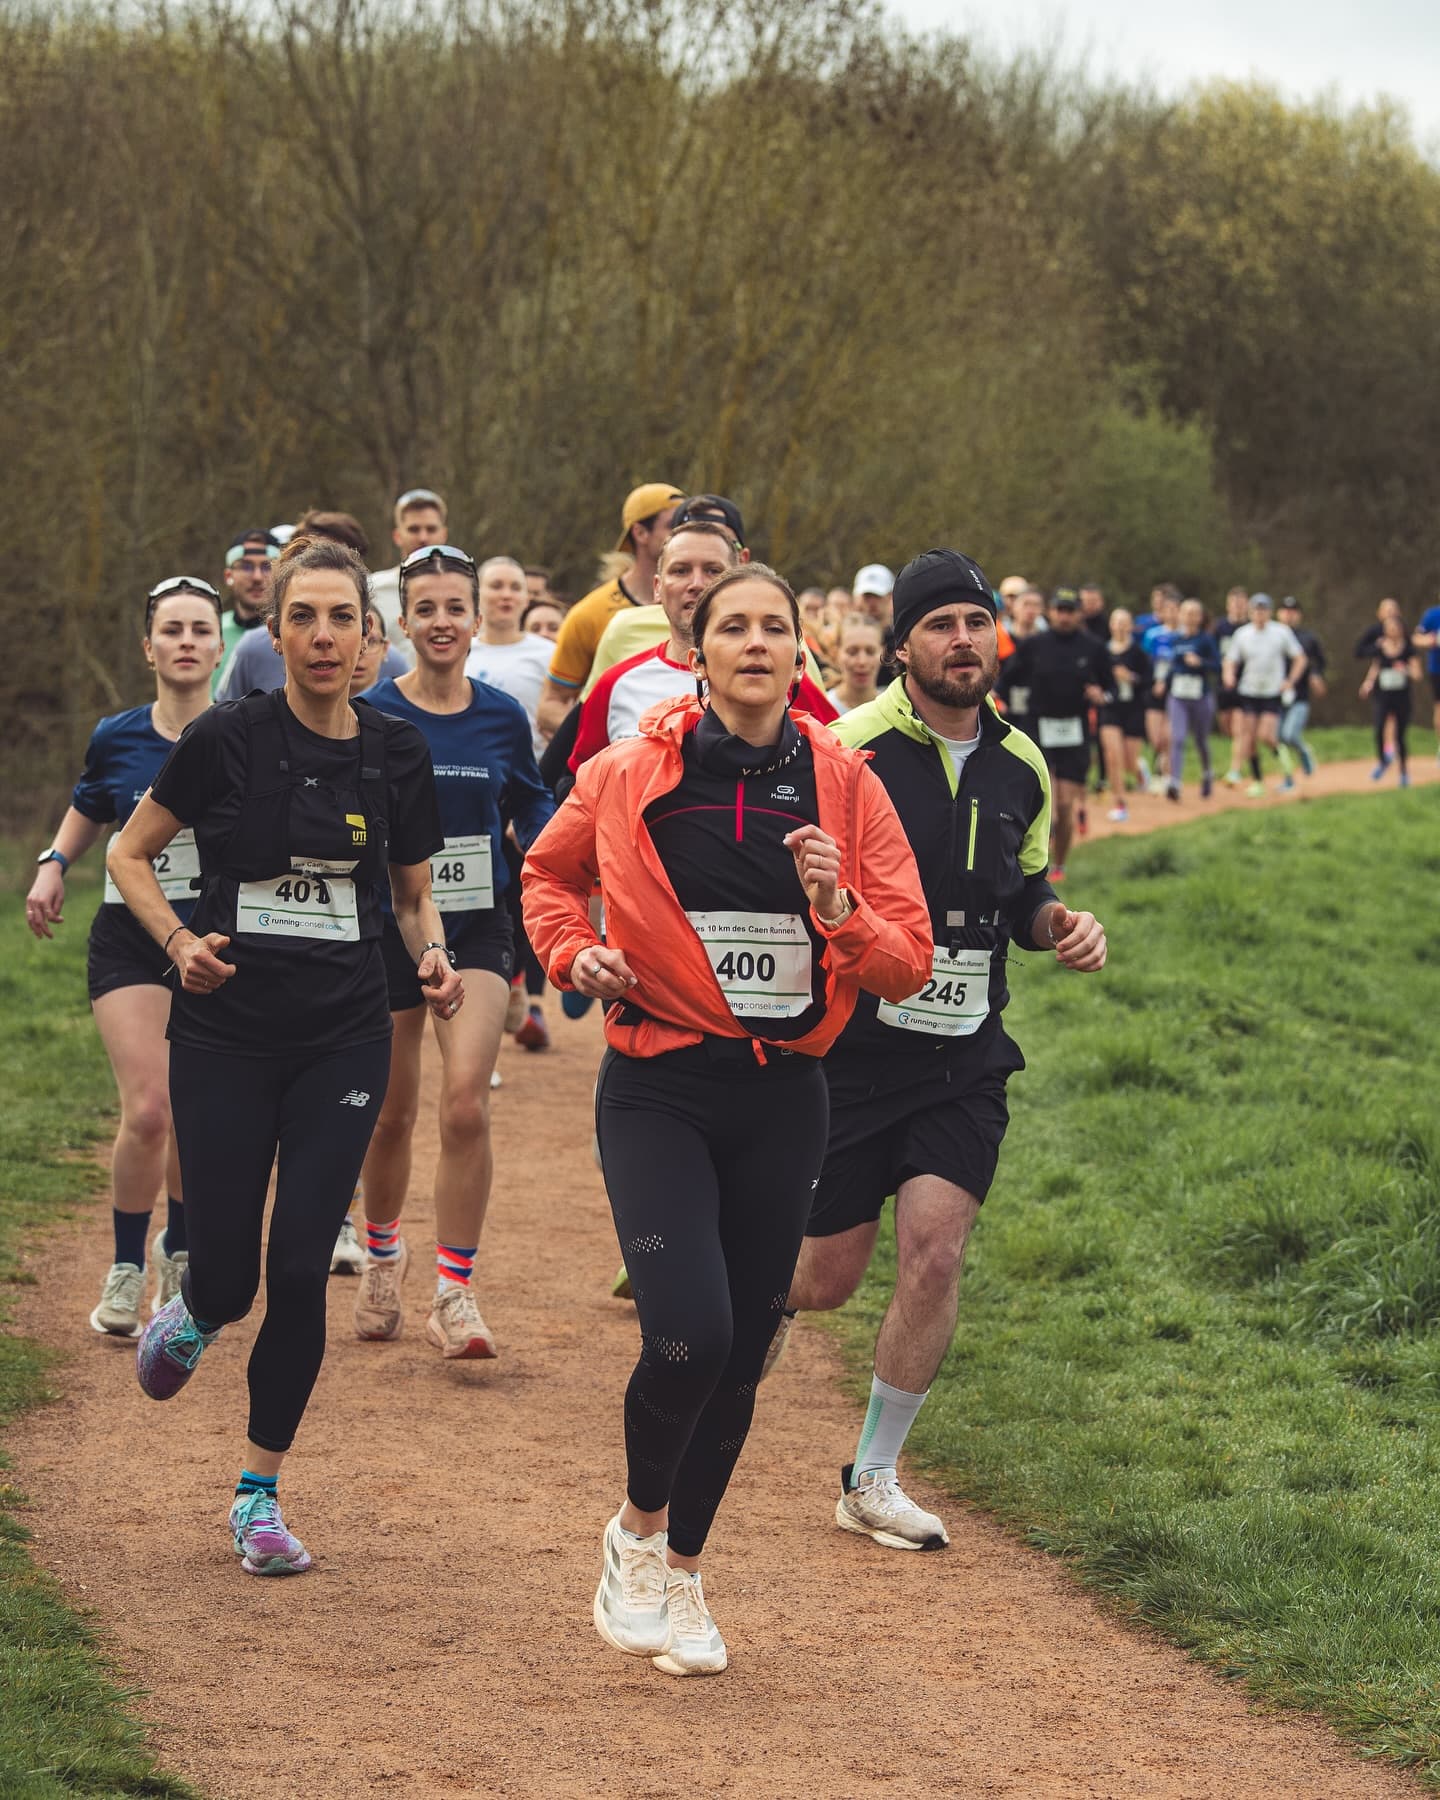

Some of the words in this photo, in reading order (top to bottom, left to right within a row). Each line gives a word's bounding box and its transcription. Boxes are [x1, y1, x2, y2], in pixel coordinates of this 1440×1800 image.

[708, 925, 716, 933] 10
[718, 925, 731, 933] km
[732, 925, 746, 933] des
[747, 925, 768, 934] Caen
[769, 926, 796, 935] Runners
[716, 951, 776, 982] 400
[918, 978, 967, 1006] 245
